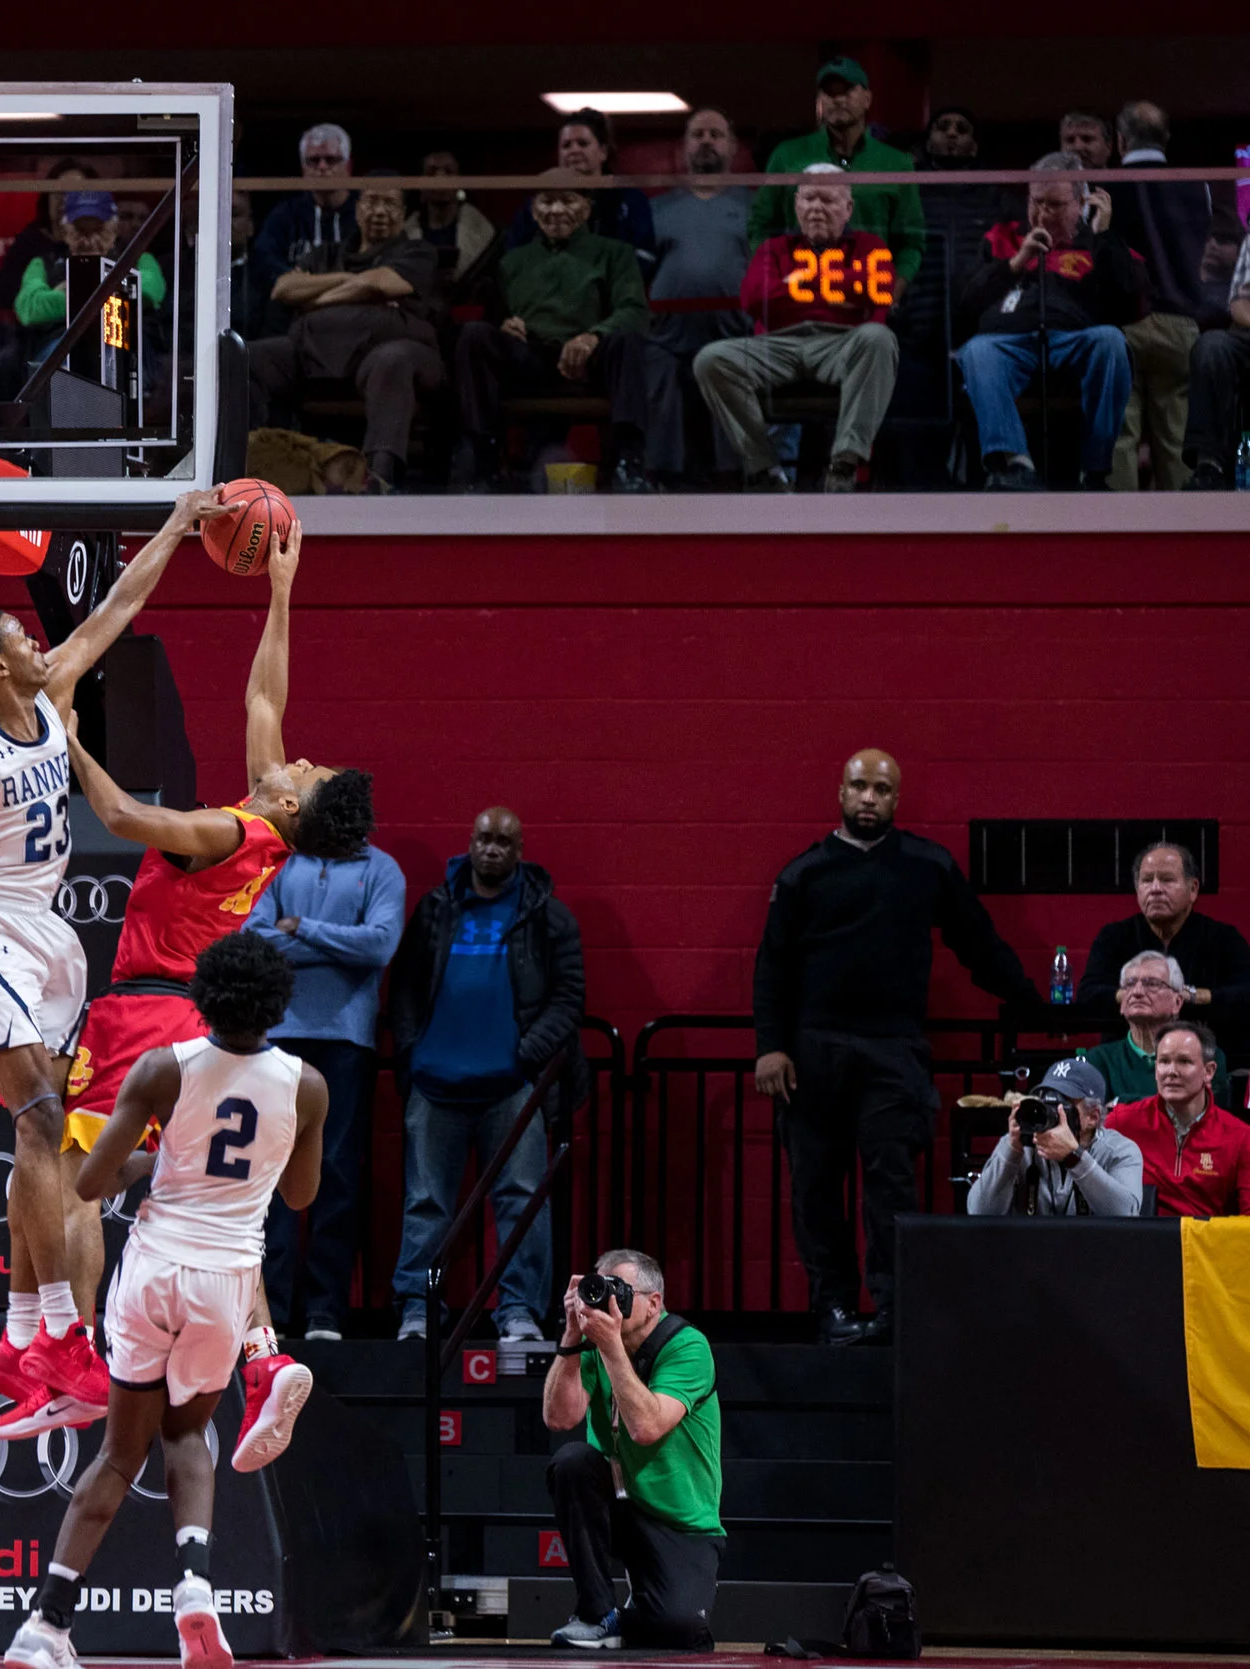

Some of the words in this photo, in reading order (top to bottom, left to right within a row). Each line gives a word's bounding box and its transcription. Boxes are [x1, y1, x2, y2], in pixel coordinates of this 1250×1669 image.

[232, 522, 265, 574] Wilson
[2, 751, 69, 808] RANNE
[24, 794, 69, 863] 23
[206, 1097, 259, 1180] 2
[468, 1354, 491, 1380] C
[440, 1416, 456, 1442] B
[544, 1536, 568, 1563] A
[74, 1587, 120, 1612] UDI
[132, 1588, 275, 1614] DEERS
